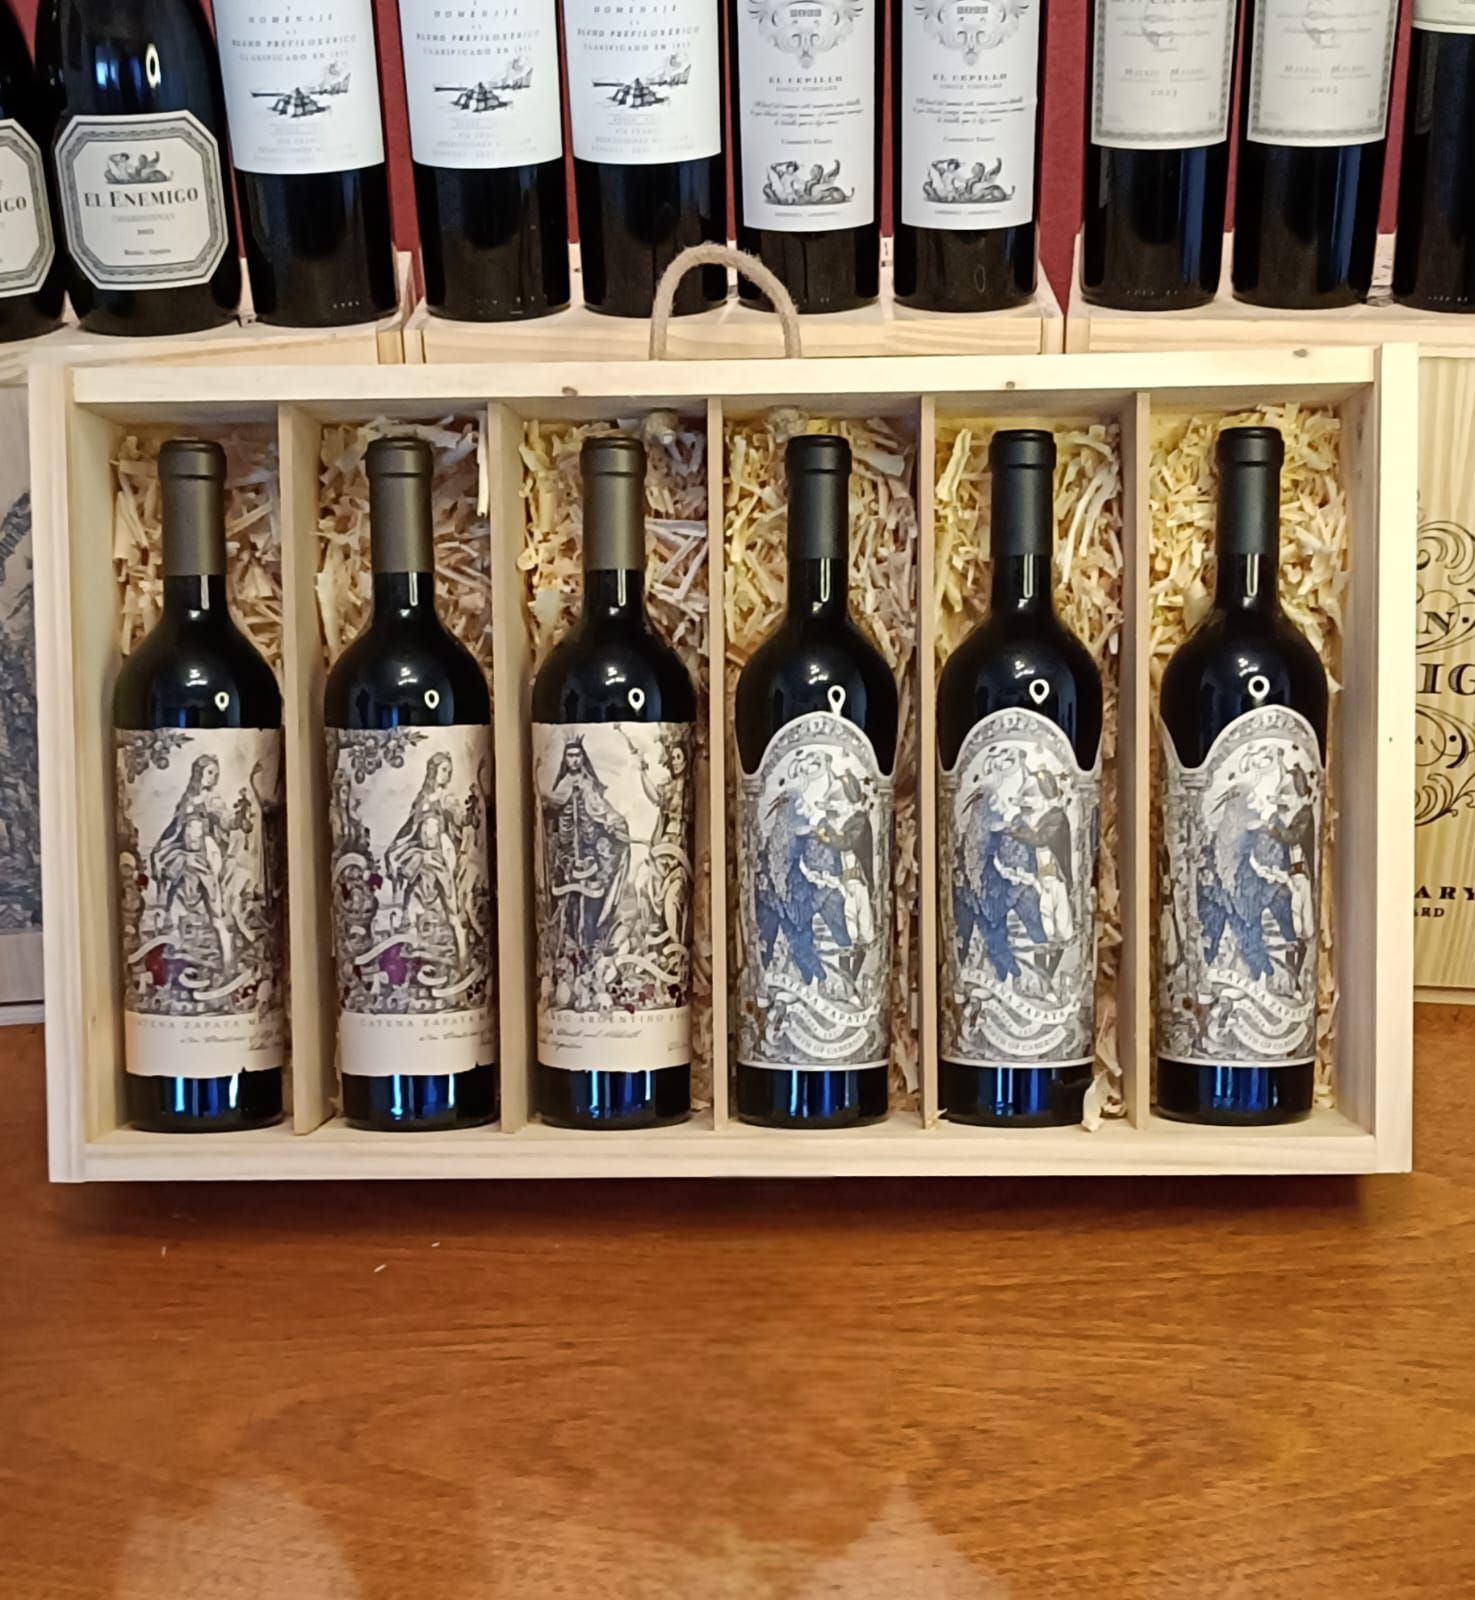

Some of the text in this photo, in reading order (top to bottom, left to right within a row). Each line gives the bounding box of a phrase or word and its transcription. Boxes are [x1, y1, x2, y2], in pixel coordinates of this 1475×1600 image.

[84, 187, 199, 208] EL ENEMIGO
[360, 1019, 415, 1028] CATENA
[423, 1015, 474, 1027] ZAPATA
[579, 1014, 664, 1023] ARGENTINO
[184, 1020, 239, 1029] ZAPATA
